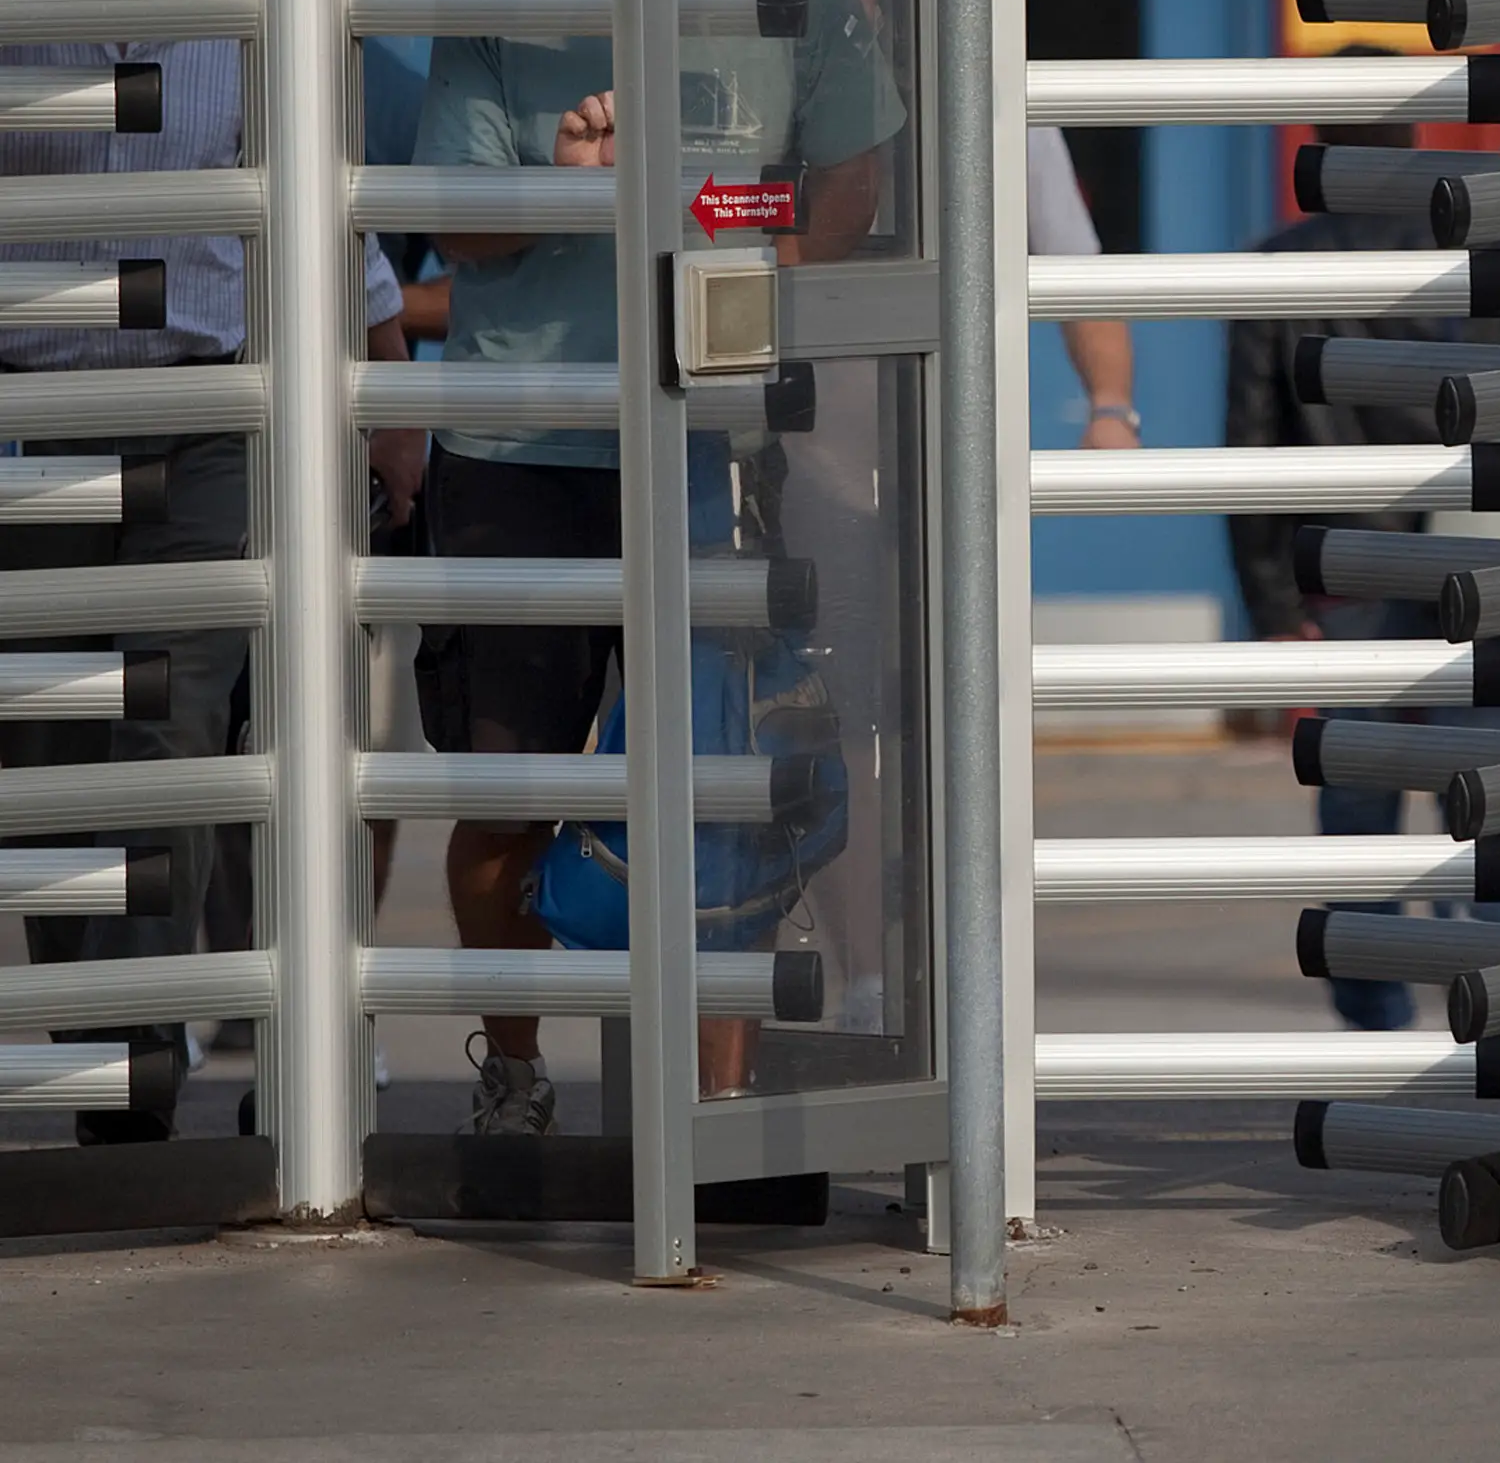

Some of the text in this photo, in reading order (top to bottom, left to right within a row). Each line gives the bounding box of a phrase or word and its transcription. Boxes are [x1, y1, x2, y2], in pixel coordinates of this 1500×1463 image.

[701, 192, 791, 205] This Scanner Opens
[714, 206, 777, 218] This Turnstyle
